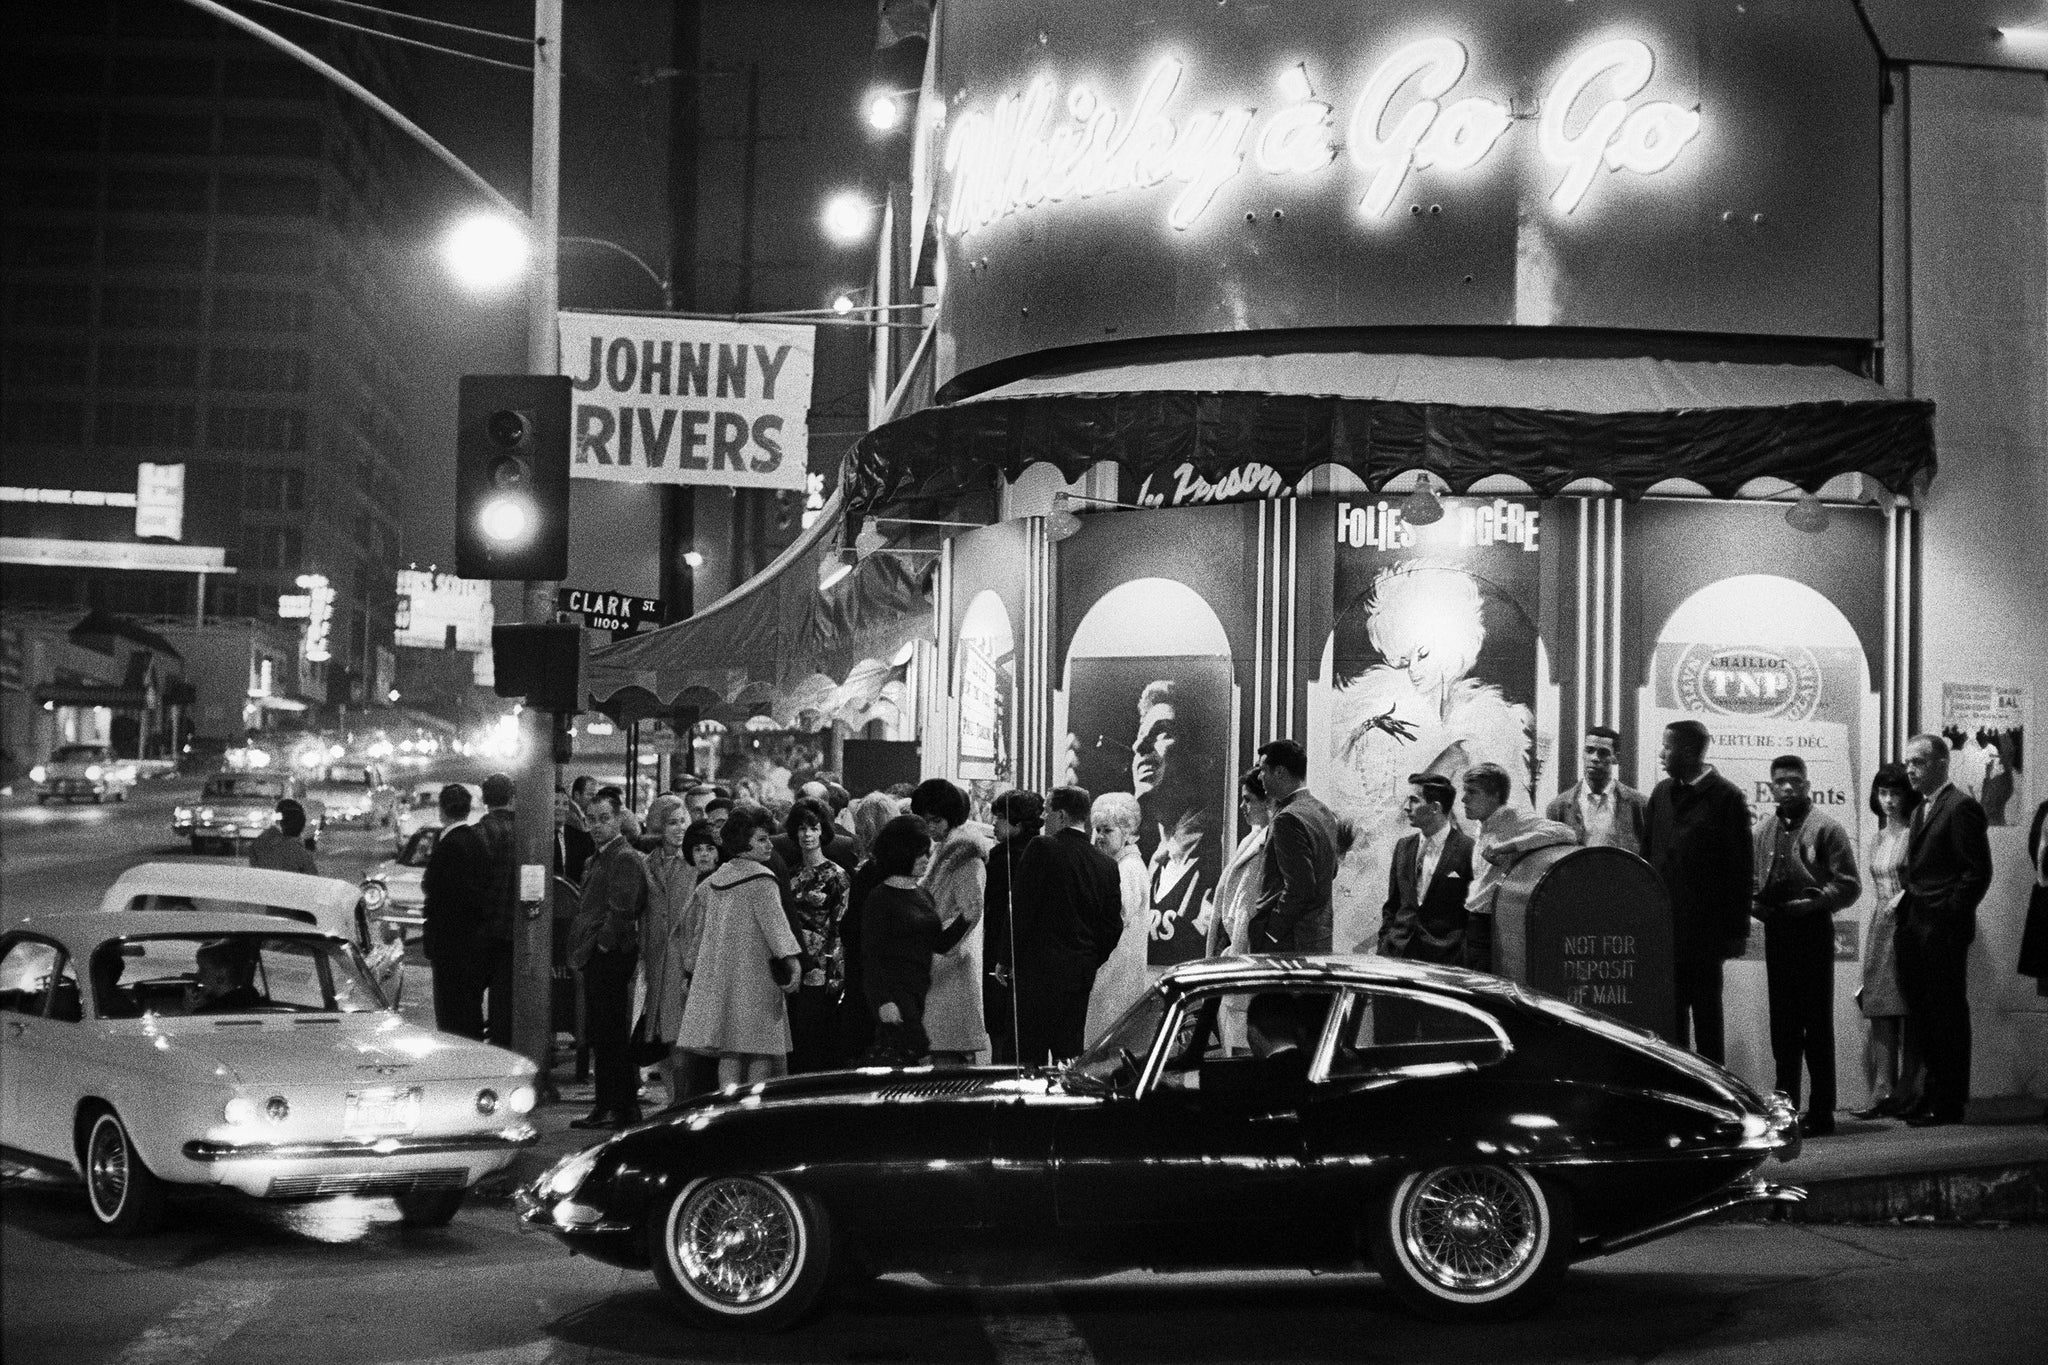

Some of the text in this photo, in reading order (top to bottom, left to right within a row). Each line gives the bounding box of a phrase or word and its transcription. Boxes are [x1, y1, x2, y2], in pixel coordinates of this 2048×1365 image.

[946, 54, 1256, 236] Whisky
[1350, 37, 1511, 217] Go
[1540, 38, 1701, 215] Go
[572, 336, 793, 400] JOHNNY
[574, 403, 784, 474] RIVERS
[569, 591, 633, 618] CLARK
[594, 616, 620, 630] 1100
[1710, 656, 1788, 669] CHAILLOT
[1708, 670, 1789, 699] TNP
[1786, 736, 1794, 747] 5
[1564, 935, 1635, 955] NOT FOR
[1563, 960, 1636, 980] DEPOSIT
[1567, 985, 1633, 1005] OF MAIL
